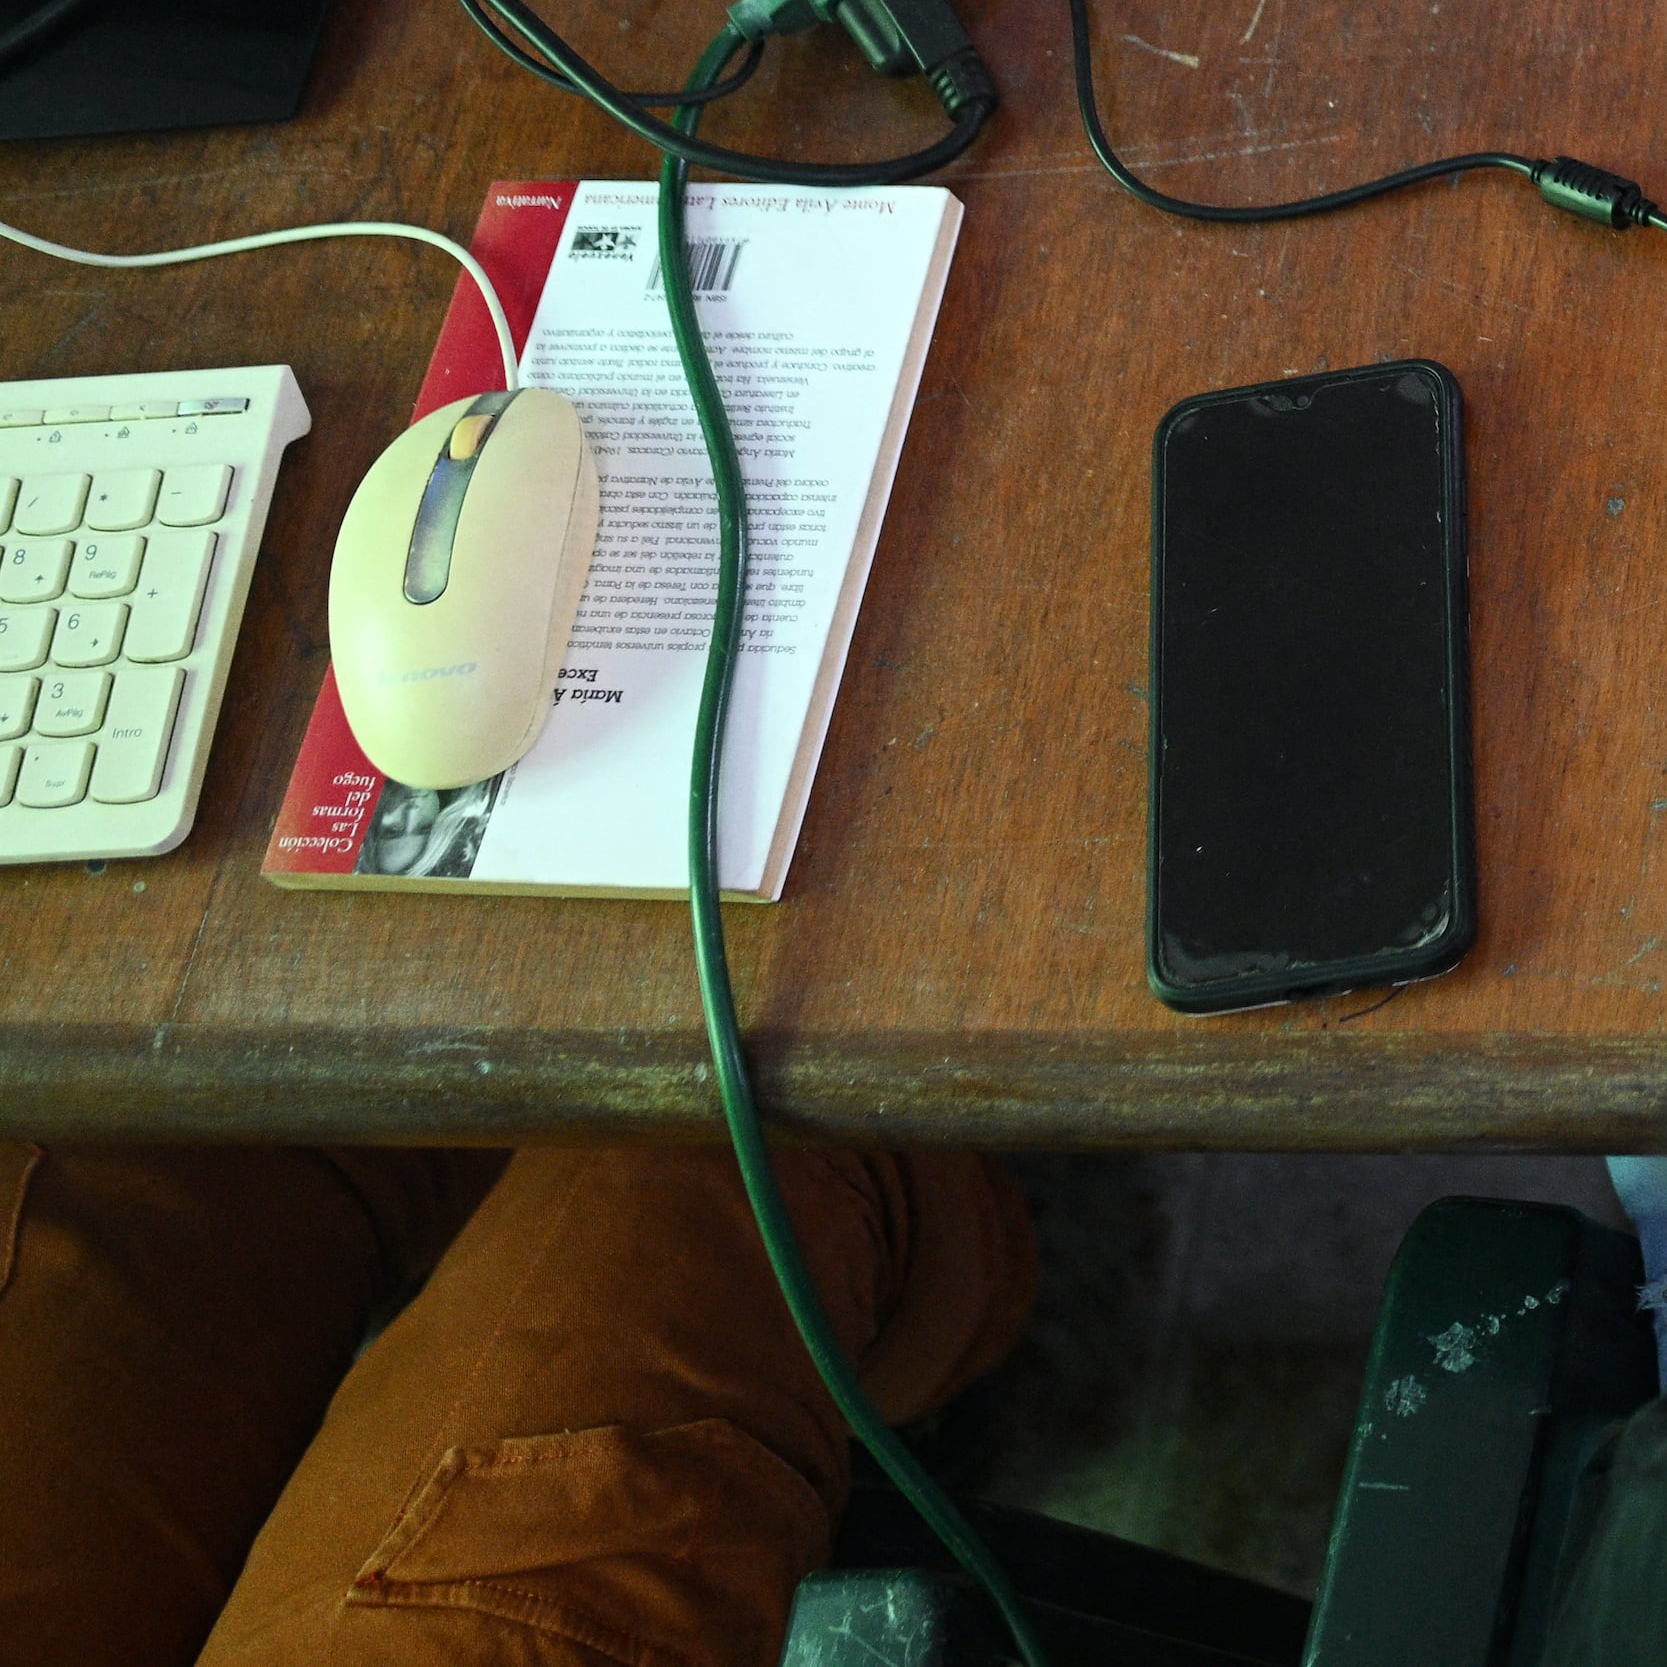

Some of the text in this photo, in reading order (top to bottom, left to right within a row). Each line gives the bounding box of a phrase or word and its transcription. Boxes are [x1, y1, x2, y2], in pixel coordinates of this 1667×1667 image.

[496, 195, 562, 210] Narrativa
[722, 196, 787, 213] Editores
[795, 197, 833, 214] Ávila
[844, 199, 896, 215] Monte
[13, 549, 26, 565] 8
[85, 544, 97, 560] 9
[68, 614, 80, 629] 6
[747, 644, 796, 654] Seducida
[51, 683, 65, 699] 3
[571, 688, 624, 704] María
[112, 727, 142, 739] Intro
[333, 771, 376, 792] fuego
[344, 792, 371, 807] del
[312, 806, 365, 822] formas
[332, 822, 359, 837] Las
[279, 837, 353, 854] Colección
